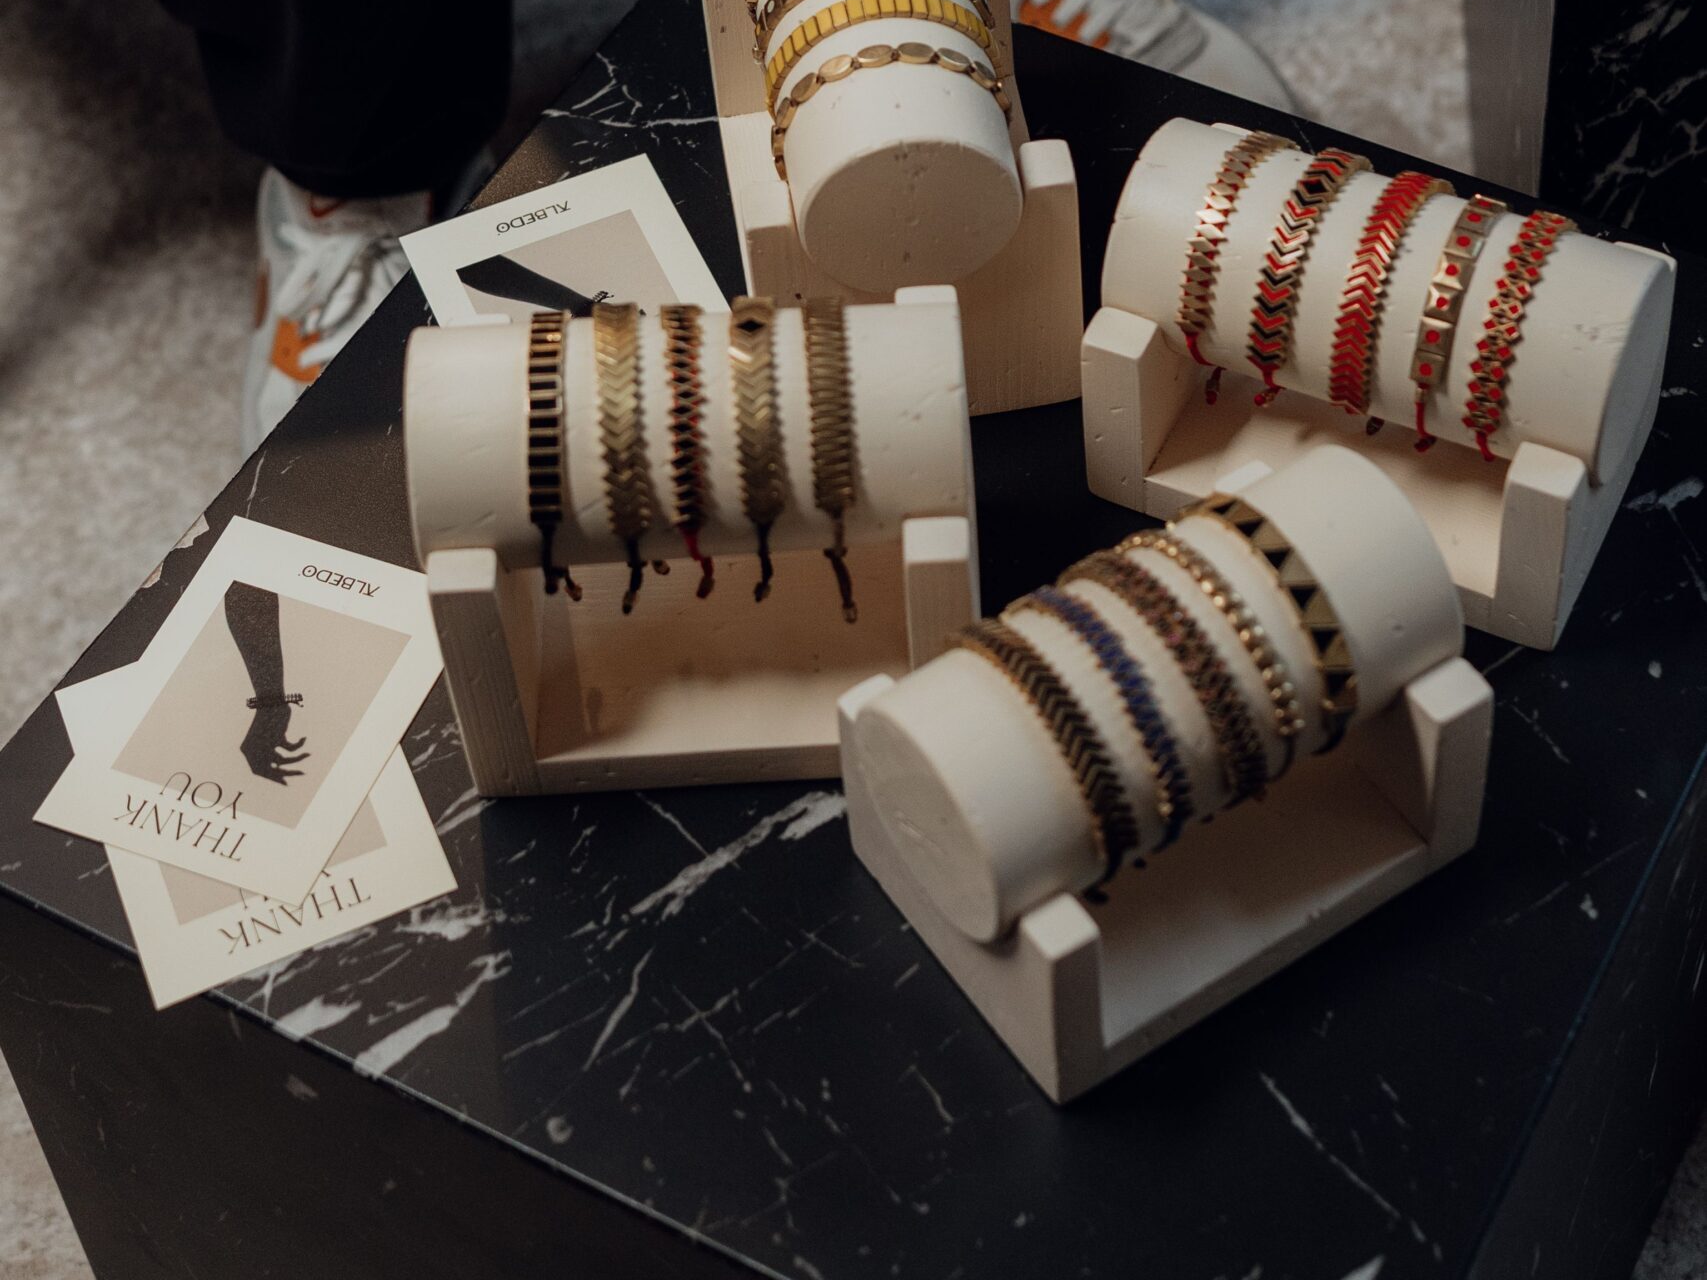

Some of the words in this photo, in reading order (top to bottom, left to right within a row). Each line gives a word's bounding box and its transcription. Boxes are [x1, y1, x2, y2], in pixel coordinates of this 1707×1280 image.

[496, 200, 571, 235] ALBEDO
[301, 564, 380, 598] ALBEDO
[159, 771, 244, 821] YOU
[113, 794, 247, 862] THANK
[217, 878, 372, 955] THANK
